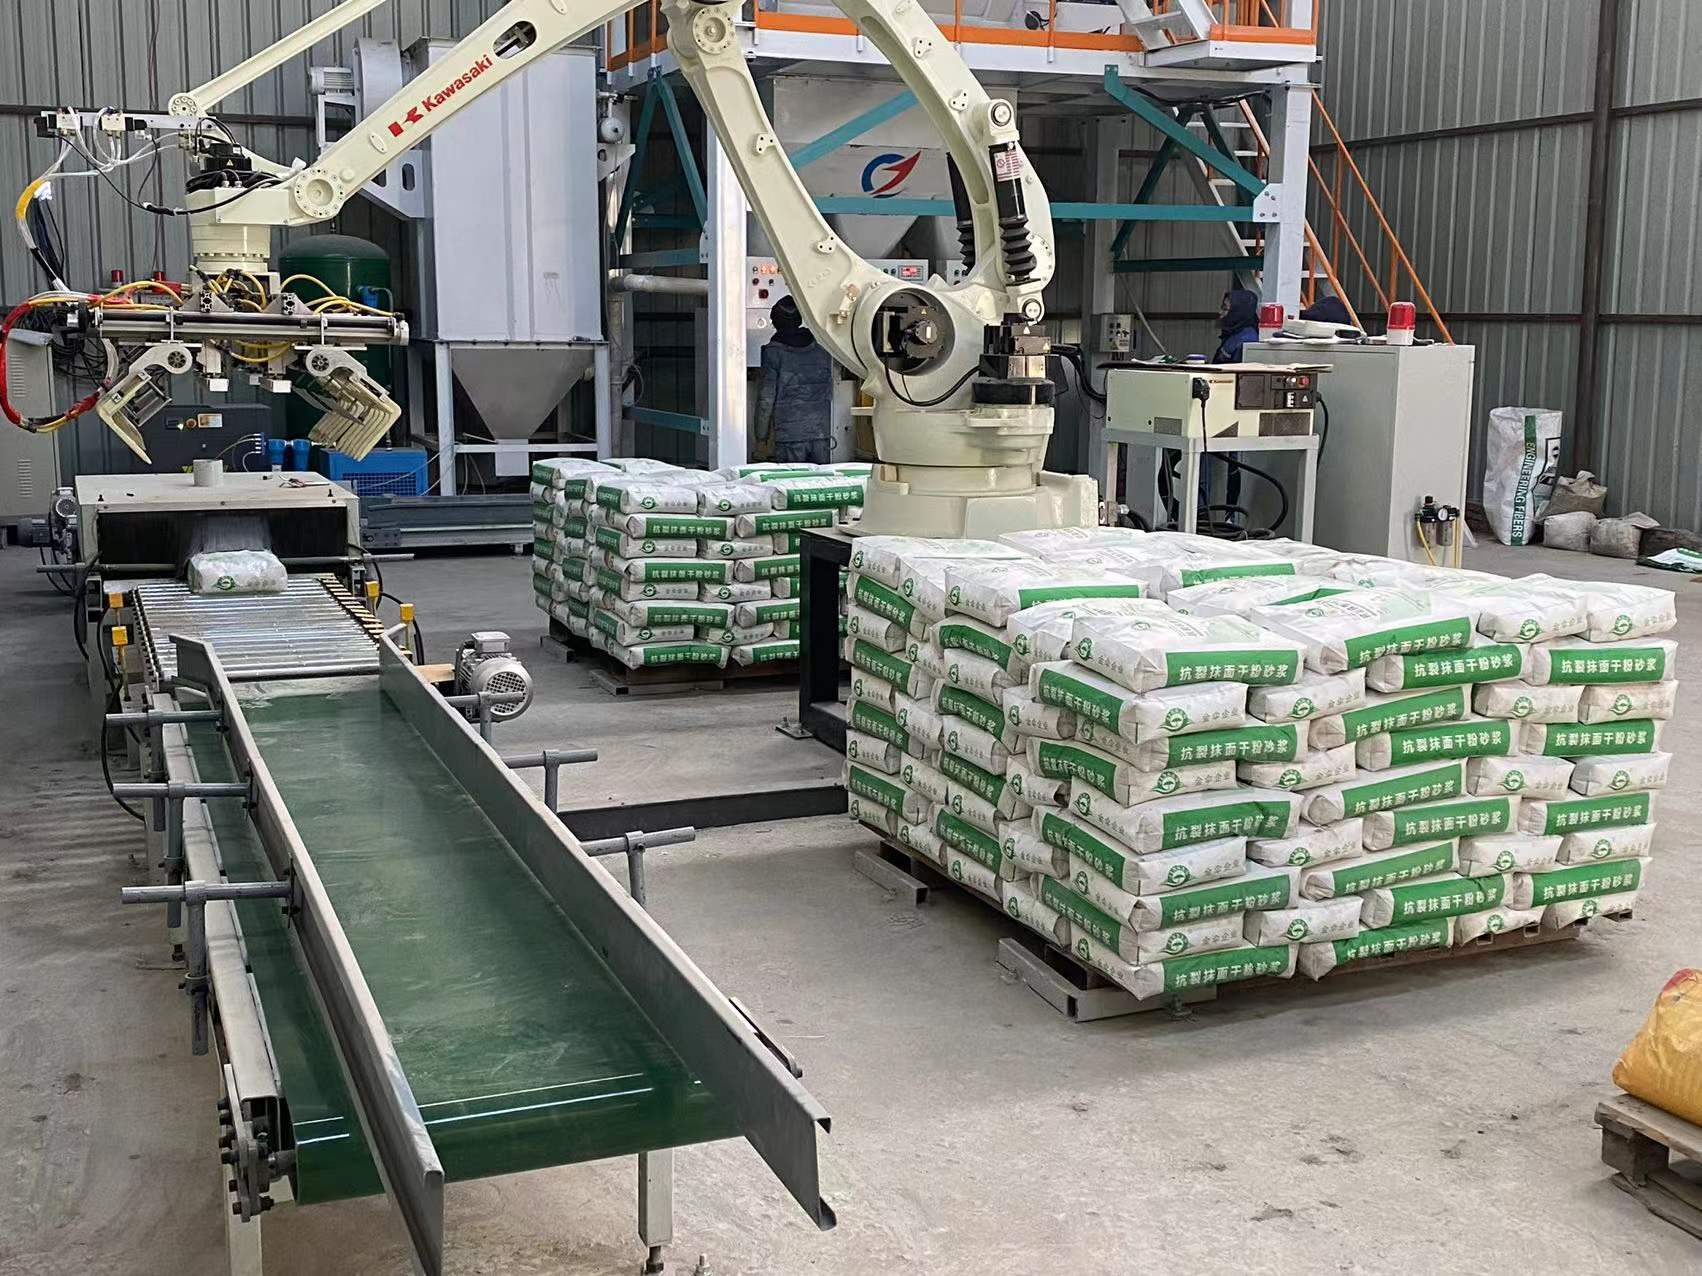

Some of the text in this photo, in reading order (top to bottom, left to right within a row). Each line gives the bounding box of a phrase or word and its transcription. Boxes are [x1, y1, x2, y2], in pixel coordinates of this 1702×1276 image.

[421, 54, 493, 112] Kawasaki
[1512, 442, 1535, 538] ENGINEERING FIBERS
[1360, 633, 1462, 664] 抗裂抹面干粉砂浆
[1179, 664, 1289, 680] 抗裂抹面干粉砂浆
[1414, 654, 1513, 677] 抗裂抹面干粉砂浆
[1561, 658, 1657, 674] 抗裂抹面干粉砂浆
[1357, 703, 1457, 736] 抗裂抹面干粉砂浆
[1180, 740, 1288, 760] 抗裂抹面干粉砂浆
[1402, 731, 1502, 754] 抗裂抹面干粉砂浆
[1555, 731, 1648, 746] 抗裂抹面干粉砂浆
[1355, 780, 1455, 812] 抗裂抹面干粉砂浆
[1405, 811, 1501, 836] 抗裂抹面干粉砂浆
[1556, 805, 1641, 827] 抗裂抹面干粉砂浆
[1345, 859, 1446, 894] 抗裂抹面干粉砂浆
[1543, 874, 1633, 898] 抗裂抹面干粉砂浆
[1174, 892, 1281, 921] 抗裂抹面干粉砂浆
[1404, 888, 1496, 915] 抗裂抹面干粉砂浆
[1347, 932, 1441, 958] 抗裂抹面干粉砂浆
[1175, 961, 1281, 987] 抗裂抹面干粉砂浆
